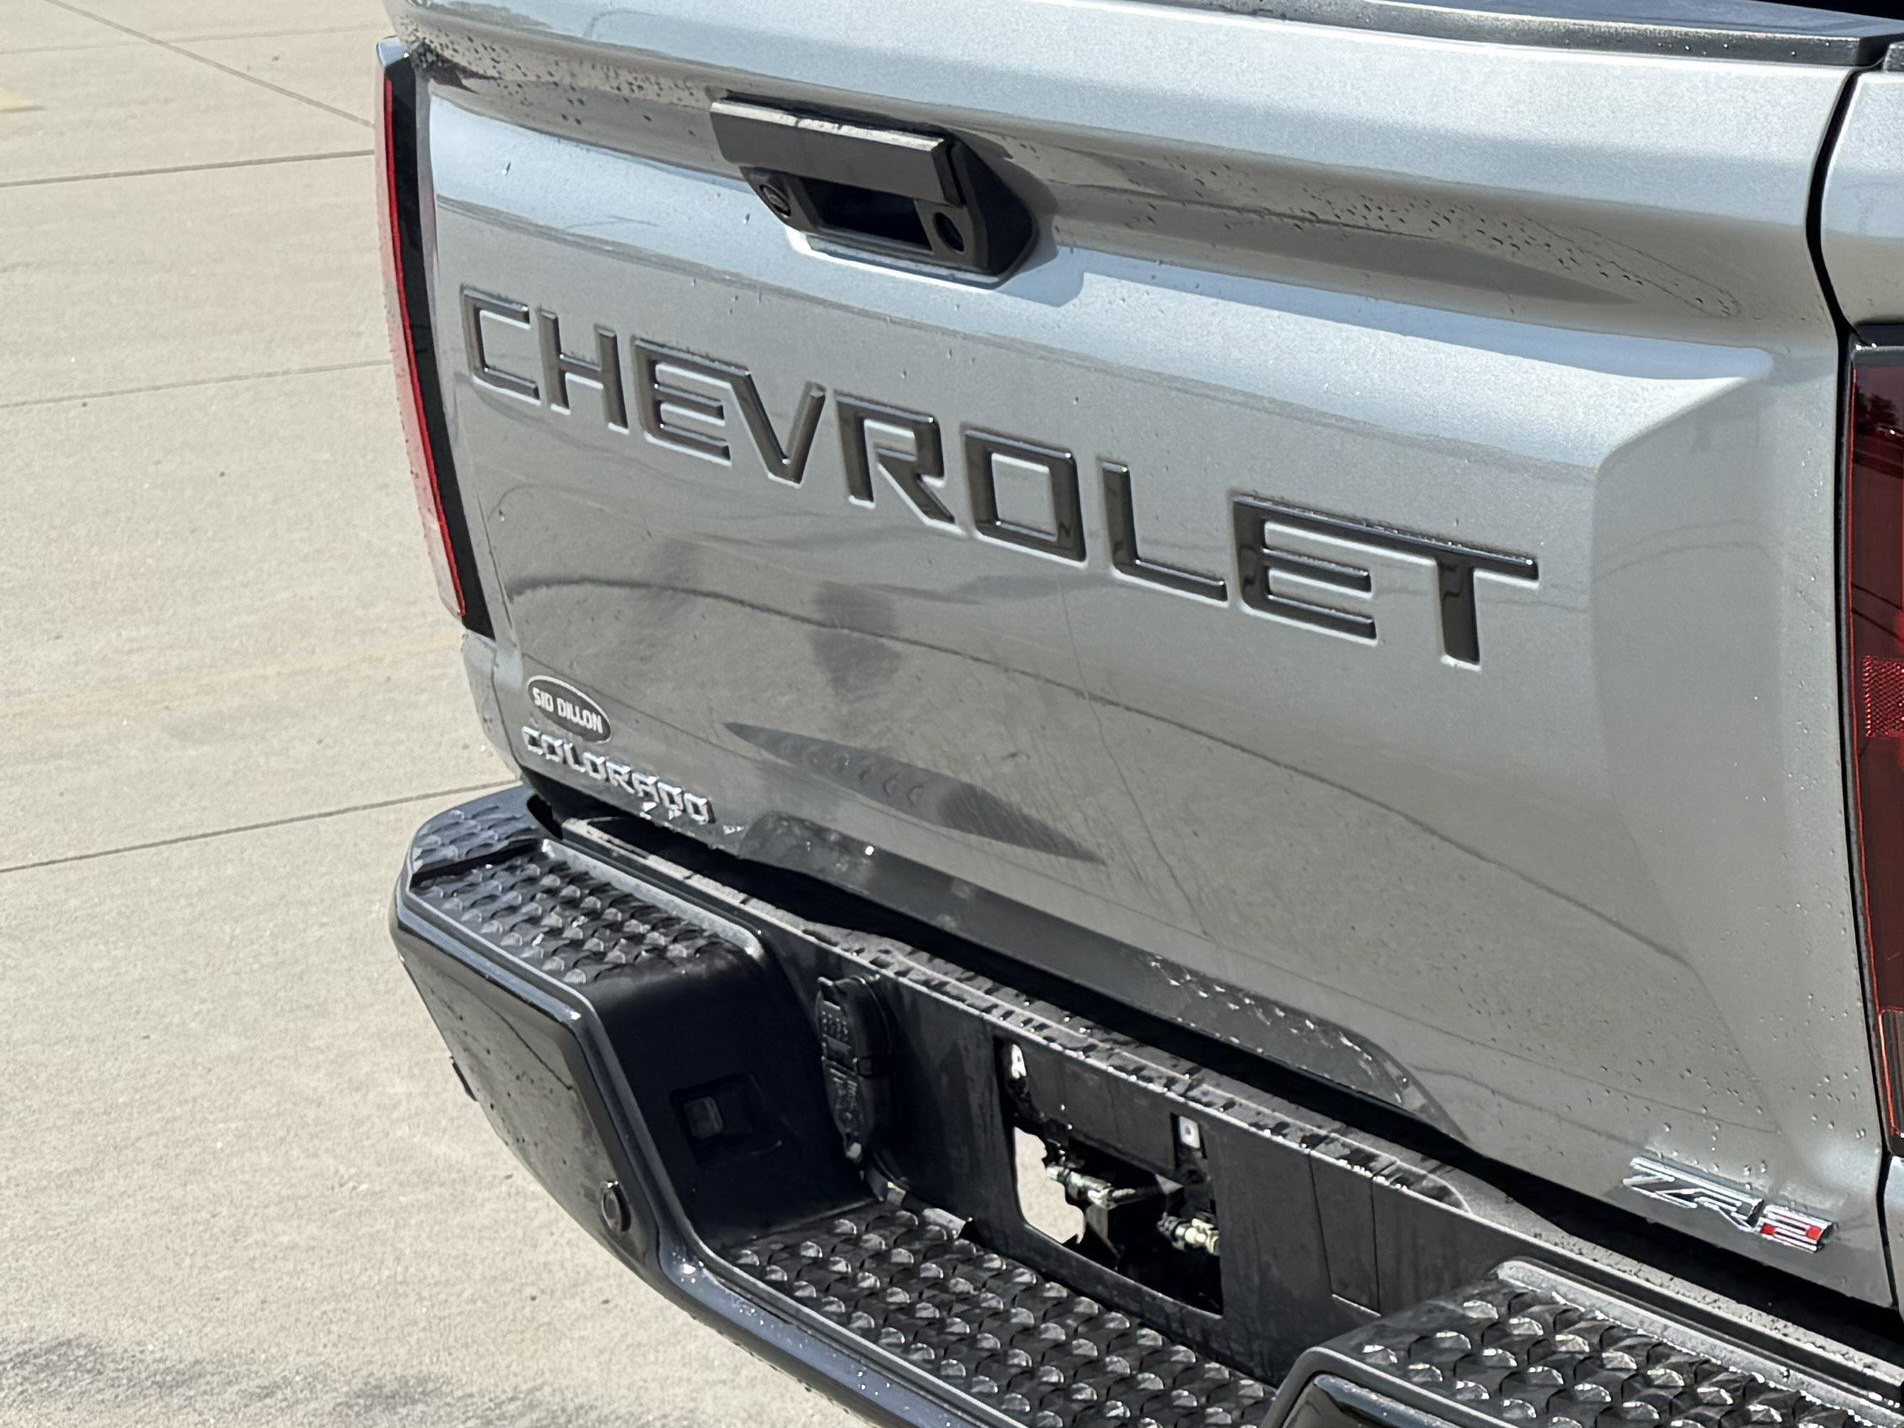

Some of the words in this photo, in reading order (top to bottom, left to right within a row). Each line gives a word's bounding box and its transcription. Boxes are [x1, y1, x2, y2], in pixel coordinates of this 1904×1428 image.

[461, 286, 1538, 667] CHEVROLET
[532, 686, 554, 713] SID
[556, 697, 604, 735] DILLON
[521, 725, 713, 824] COLORADO
[1622, 1155, 1836, 1253] ZR2
